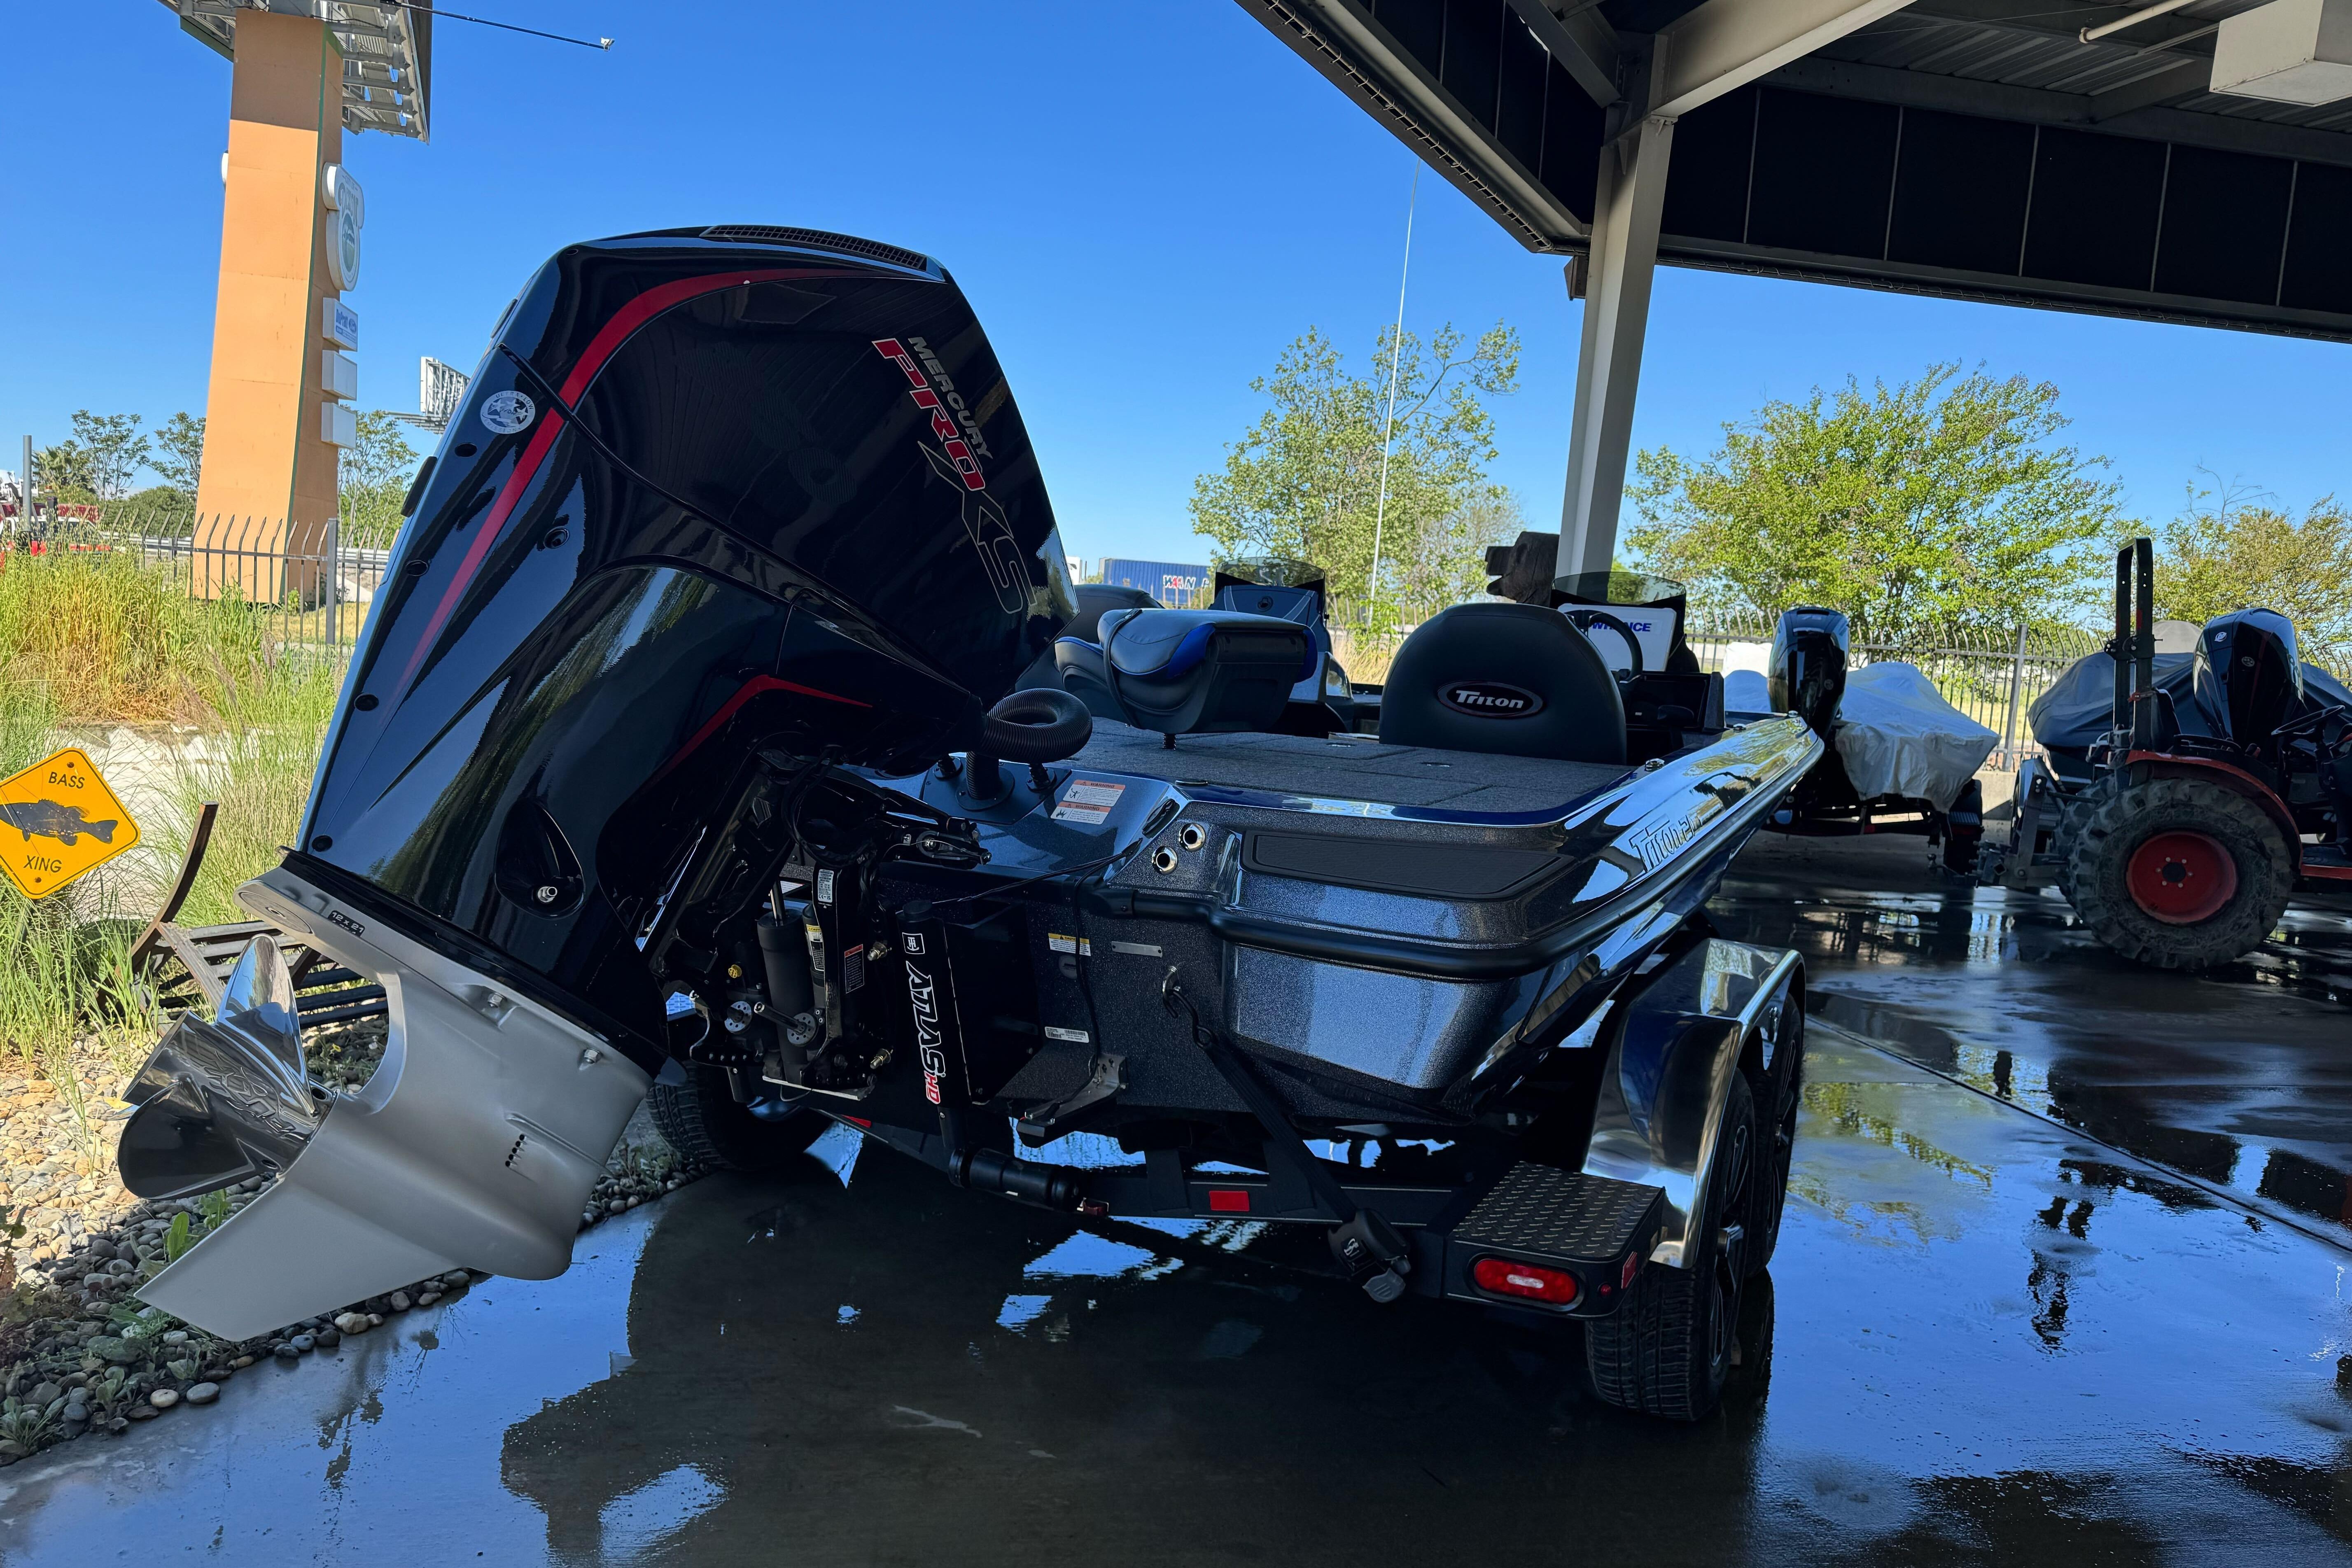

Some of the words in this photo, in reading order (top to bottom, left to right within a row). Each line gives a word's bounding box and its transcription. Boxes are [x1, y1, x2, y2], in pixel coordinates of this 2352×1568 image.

[872, 338, 986, 491] PRO
[908, 336, 993, 460] MERCURY
[917, 437, 1038, 615] XS
[49, 771, 85, 789] BASS
[23, 854, 63, 873] XING
[331, 912, 344, 922] 12
[350, 923, 366, 933] 21
[905, 960, 946, 1078] ATLAS
[924, 1070, 941, 1105] HD
